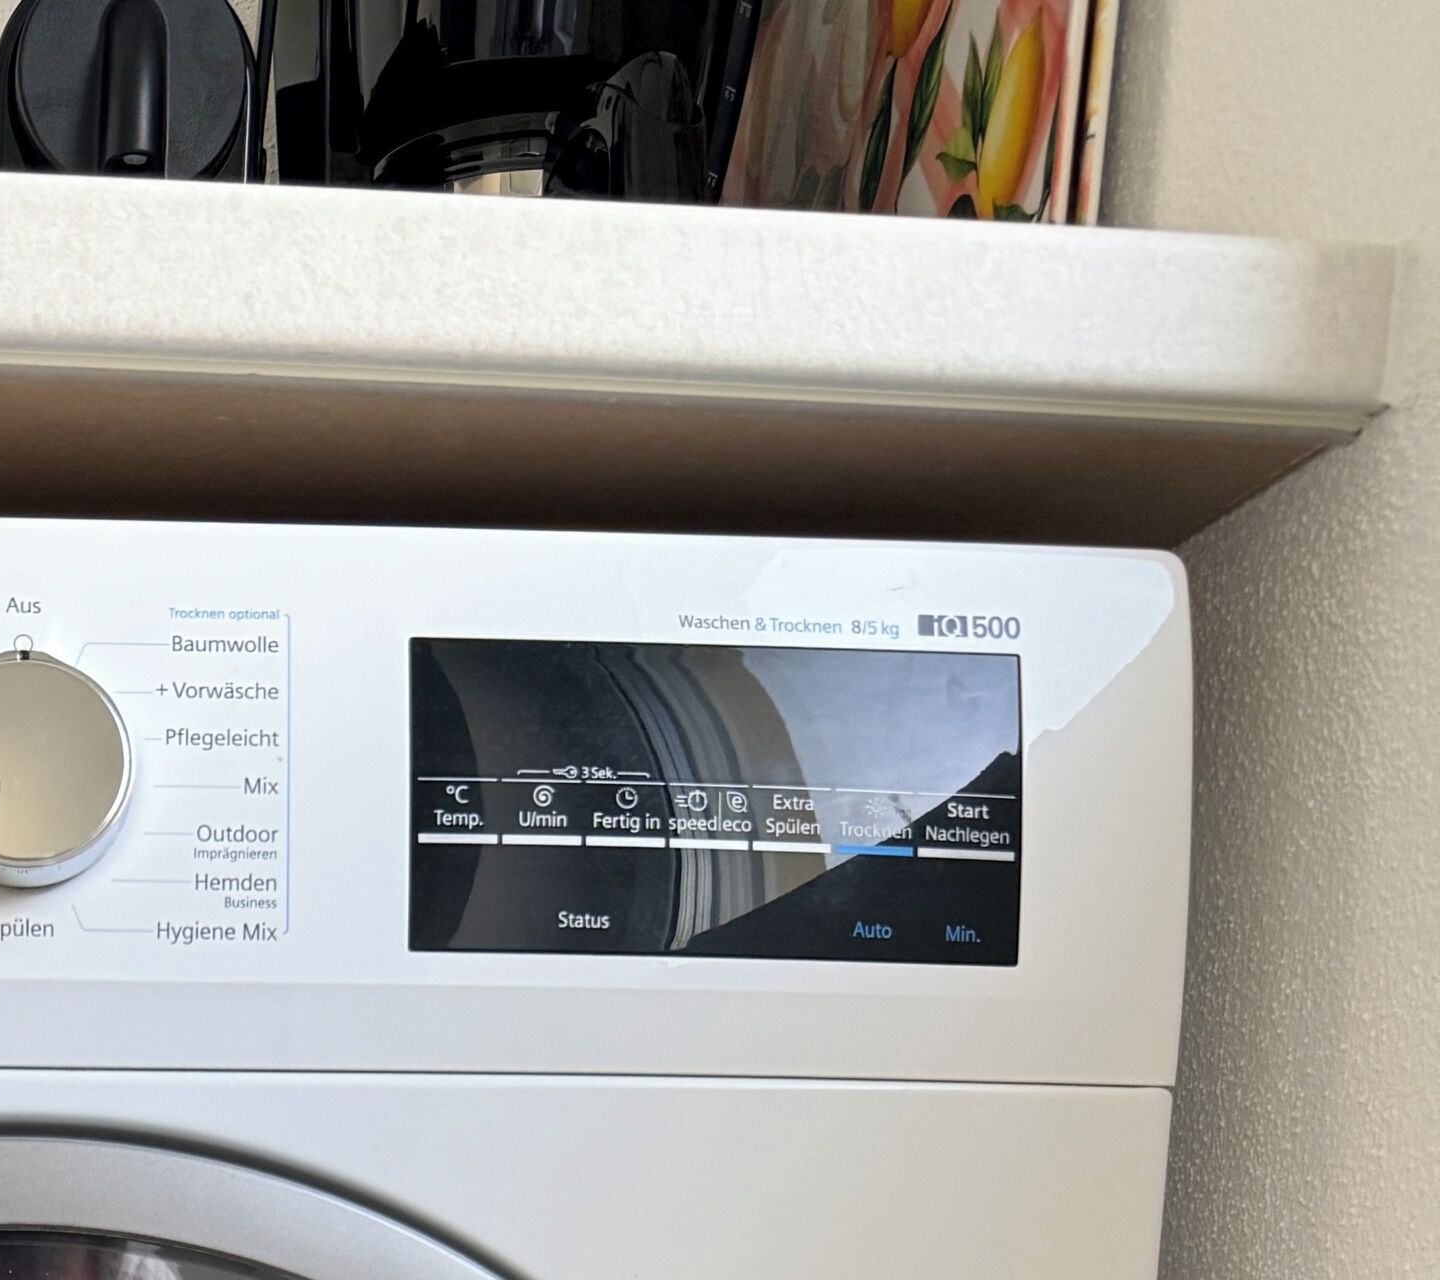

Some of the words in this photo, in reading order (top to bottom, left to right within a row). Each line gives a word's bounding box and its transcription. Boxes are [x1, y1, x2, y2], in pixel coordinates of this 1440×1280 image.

[5, 597, 41, 615] Aus
[169, 608, 225, 619] Trocknen
[229, 609, 280, 621] optional
[679, 615, 750, 631] Waschen
[755, 618, 767, 631] &
[770, 617, 842, 635] Trocknen
[851, 620, 878, 636] 8/5
[882, 619, 900, 639] kg
[172, 635, 279, 653] Baumwolle
[172, 682, 279, 700] Vorwäsche
[165, 728, 279, 751] Pflegeleicht
[581, 767, 589, 779] 3
[591, 767, 617, 779] Sek.
[244, 777, 279, 795] Mix
[446, 785, 469, 804] °C
[773, 794, 814, 810] Extra
[947, 803, 989, 820] Start
[434, 810, 484, 830] Temp.
[518, 810, 567, 828] U/min
[593, 812, 639, 832] Fertig
[645, 812, 660, 830] in
[668, 814, 717, 834] speed
[722, 818, 752, 832] eco
[765, 818, 820, 837] Spülen
[197, 824, 279, 843] Outdoor
[840, 821, 912, 840] Trocknen
[925, 825, 1010, 847] Nachlegen
[194, 848, 277, 863] Imprägnieren
[195, 873, 278, 892] Hemden
[225, 896, 277, 909] Business
[558, 911, 611, 930] Status
[157, 921, 236, 945] Hygiene
[243, 922, 278, 942] Mix
[852, 921, 893, 940] Auto
[945, 925, 981, 943] Min.
